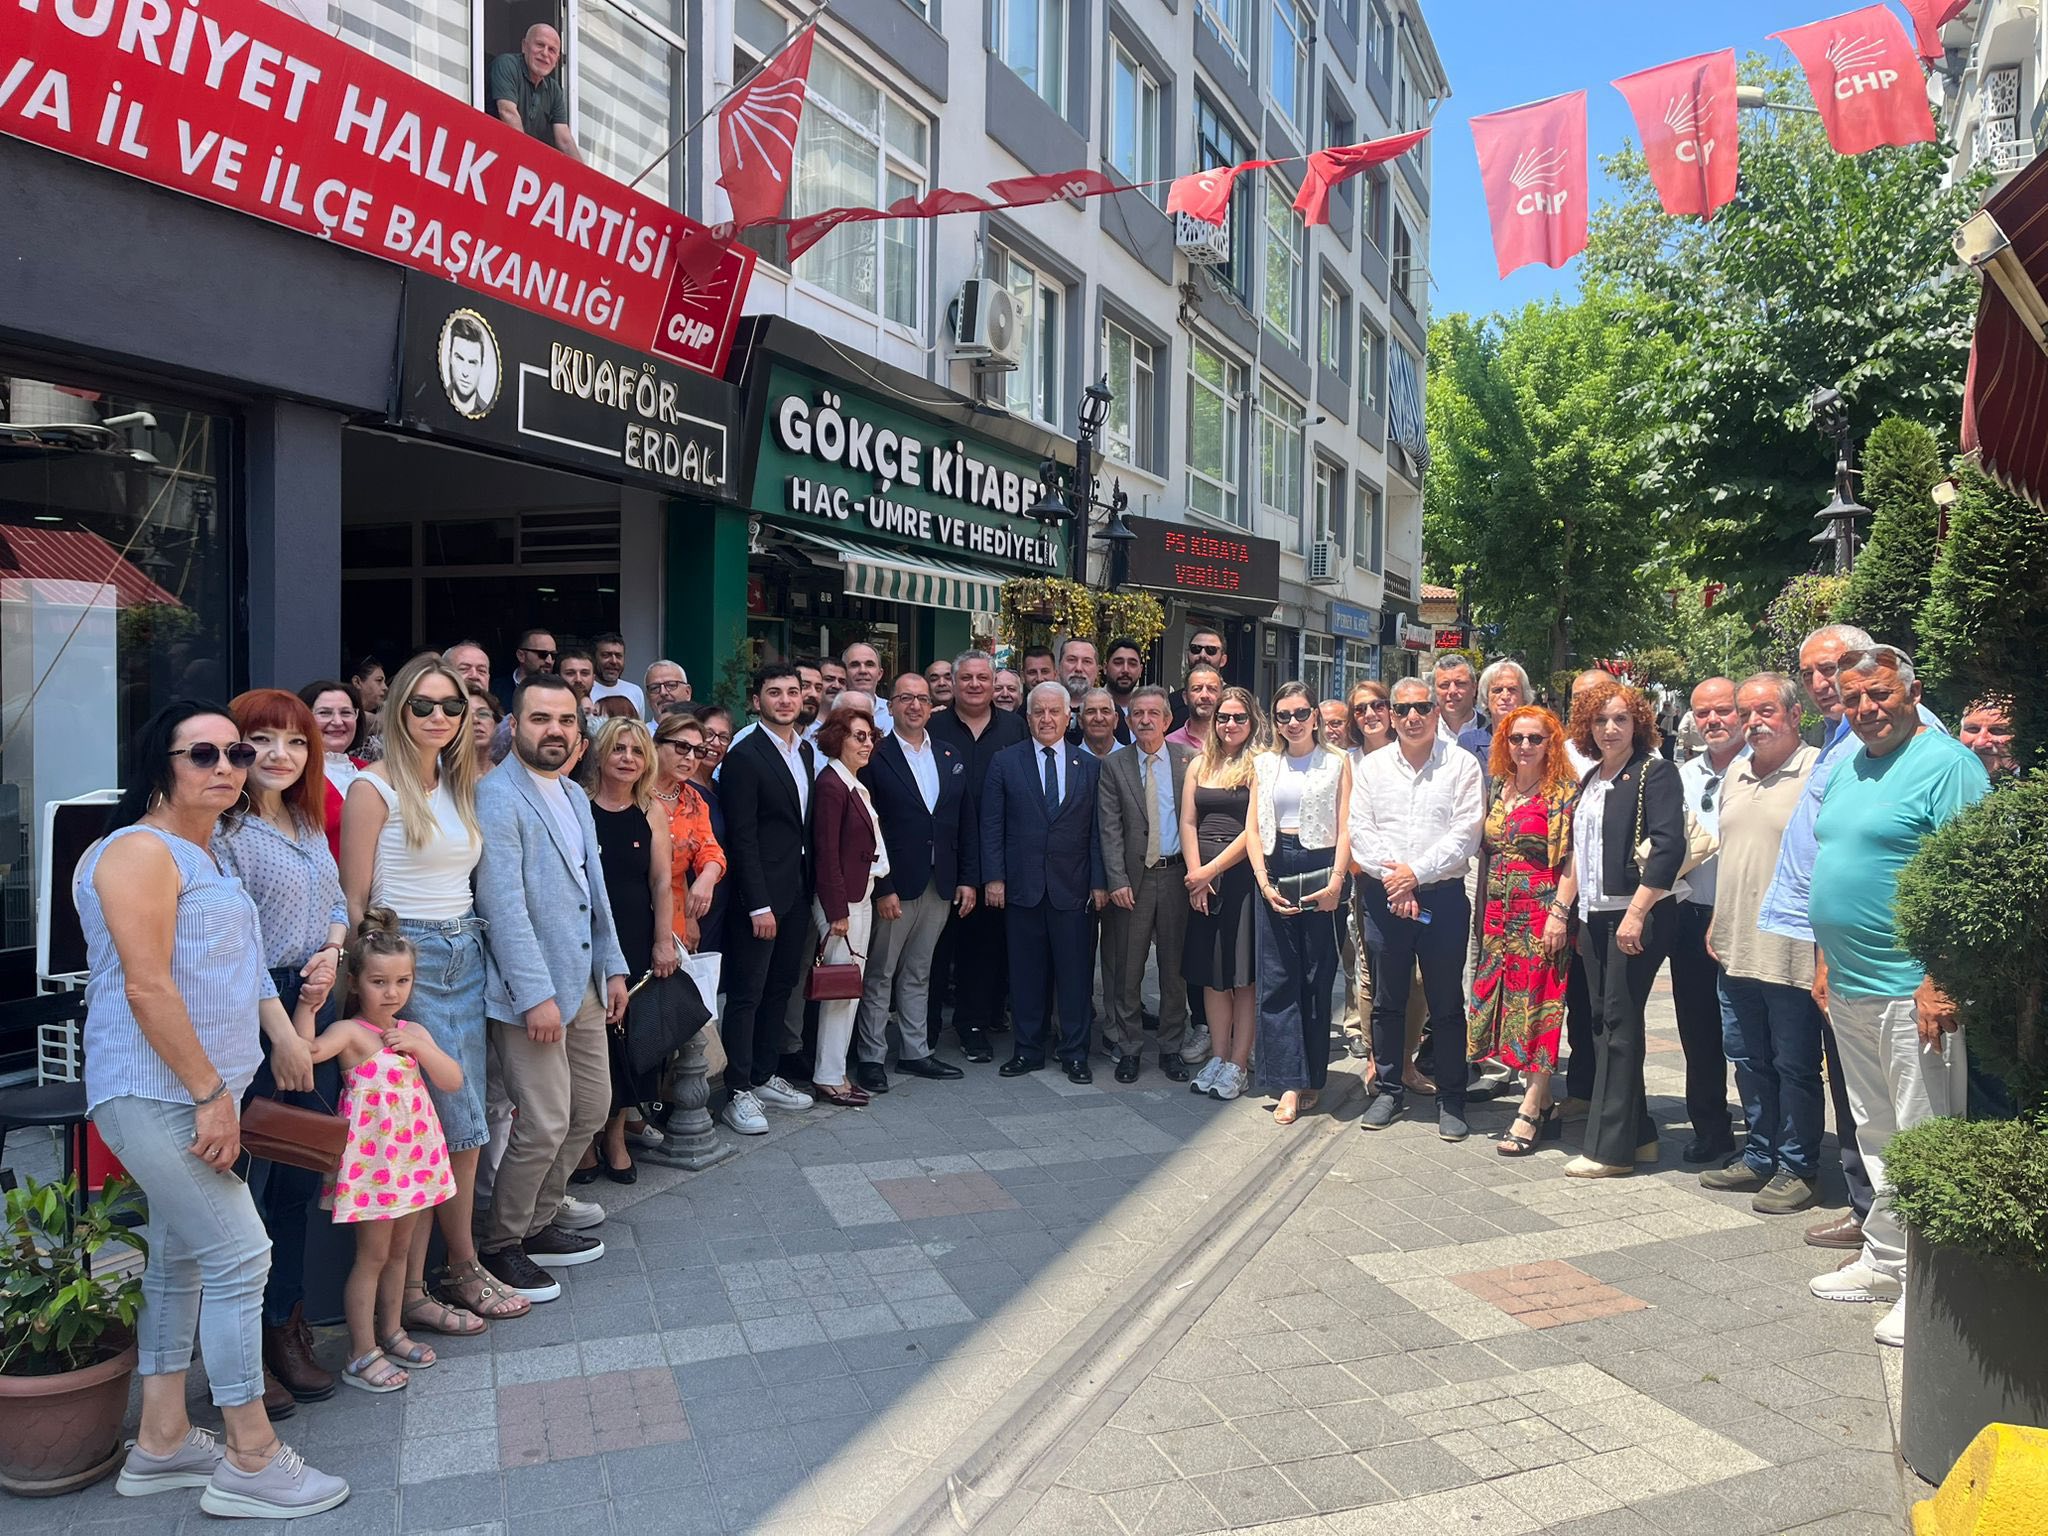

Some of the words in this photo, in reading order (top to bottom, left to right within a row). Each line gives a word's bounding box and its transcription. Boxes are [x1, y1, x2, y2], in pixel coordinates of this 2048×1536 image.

[1834, 69, 1898, 100] CHP
[96, 80, 148, 159] İL
[177, 118, 248, 192] VE
[260, 145, 373, 239] İLÇE
[383, 204, 625, 331] BAŞKANLIĞI
[334, 83, 498, 205] HALK
[506, 164, 672, 280] PARTİSİ
[1516, 189, 1568, 215] CHP
[667, 313, 715, 350] CHP
[551, 342, 679, 425] KUAFÖR
[624, 422, 717, 486] ERDAL
[779, 390, 921, 493] GÖKÇE
[792, 476, 849, 520] HAC
[869, 496, 931, 539] UMRE
[938, 516, 964, 547] VE
[970, 524, 1058, 567] HEDİYELİK
[1165, 532, 1186, 553] PS
[1191, 531, 1249, 563] KİRAYA
